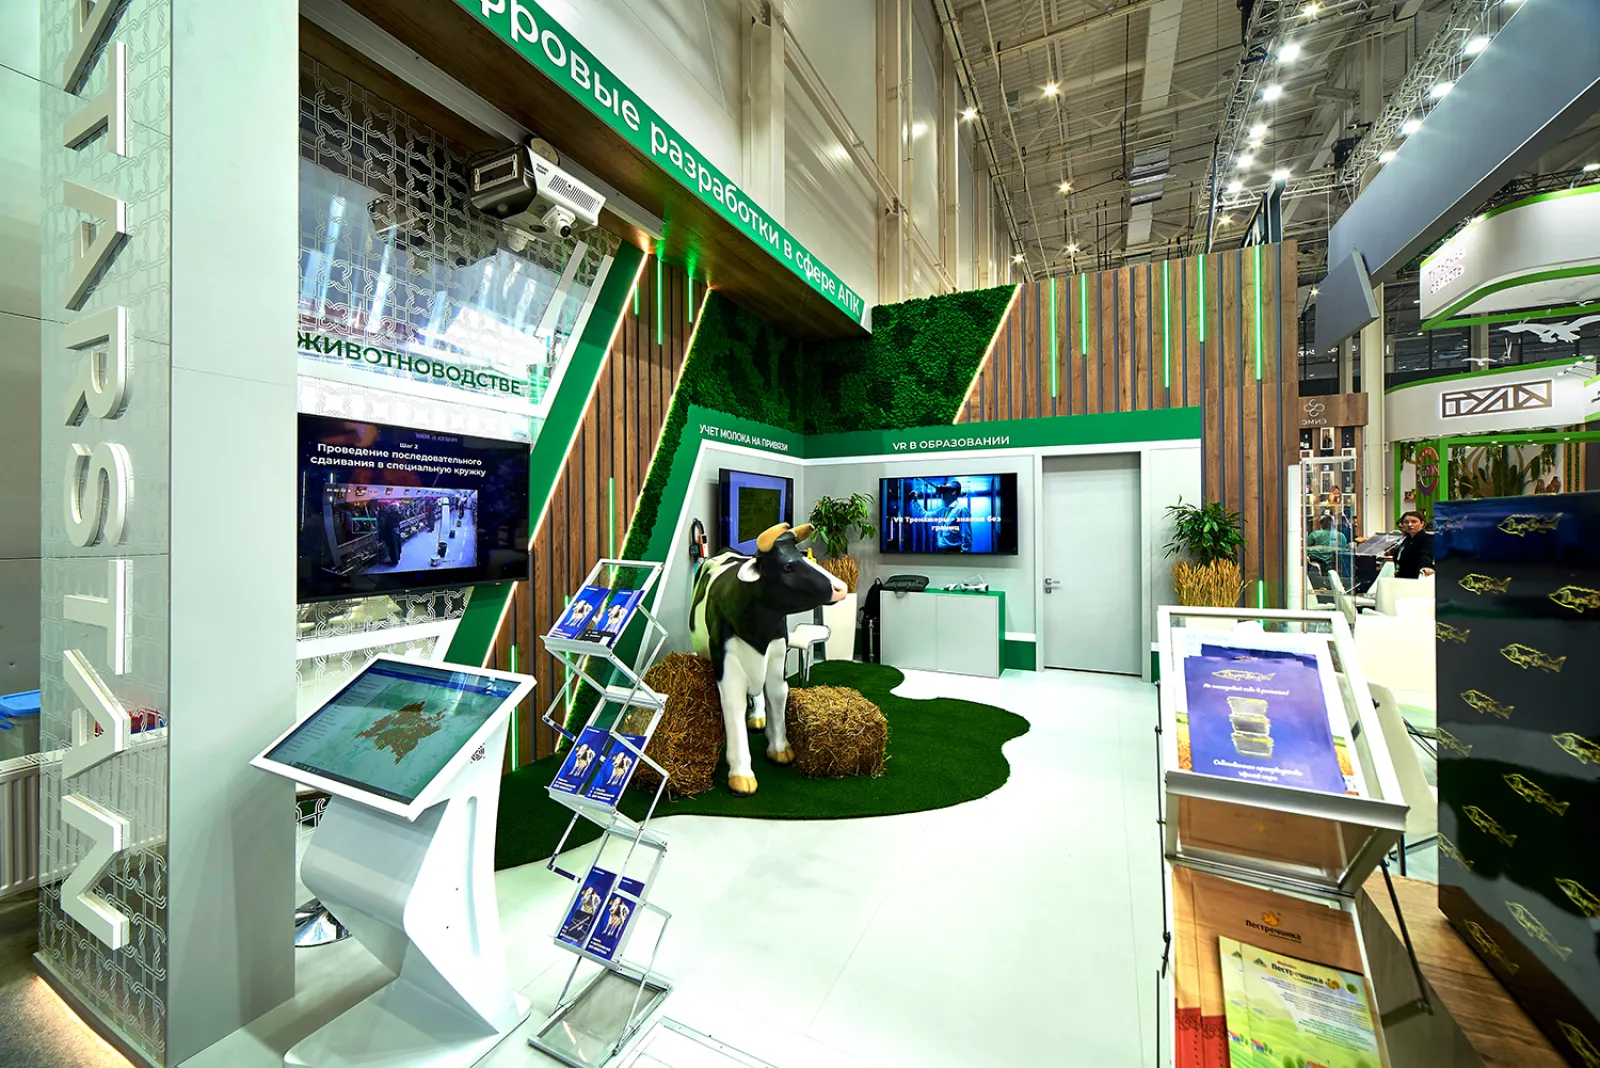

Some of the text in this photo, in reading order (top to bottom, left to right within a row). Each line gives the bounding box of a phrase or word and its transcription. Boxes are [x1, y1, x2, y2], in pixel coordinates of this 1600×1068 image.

[651, 121, 779, 249] разработки
[783, 238, 793, 260] в
[796, 251, 835, 295] сфере
[838, 284, 860, 317] АПК
[297, 331, 520, 395] ЖИВОТНОВОДСТВЕ
[699, 423, 788, 451] УЧЕТ МОЛОКА НА ПРИВЯЗИ
[893, 435, 1010, 451] VR В ОБРАЗОВАНИИ
[317, 443, 482, 466] Проведение последовательного
[310, 456, 375, 468] сдаивания
[386, 461, 452, 474] специальную
[454, 468, 486, 478] кружку
[987, 515, 1001, 523] без
[1245, 919, 1302, 941] Пестречинка
